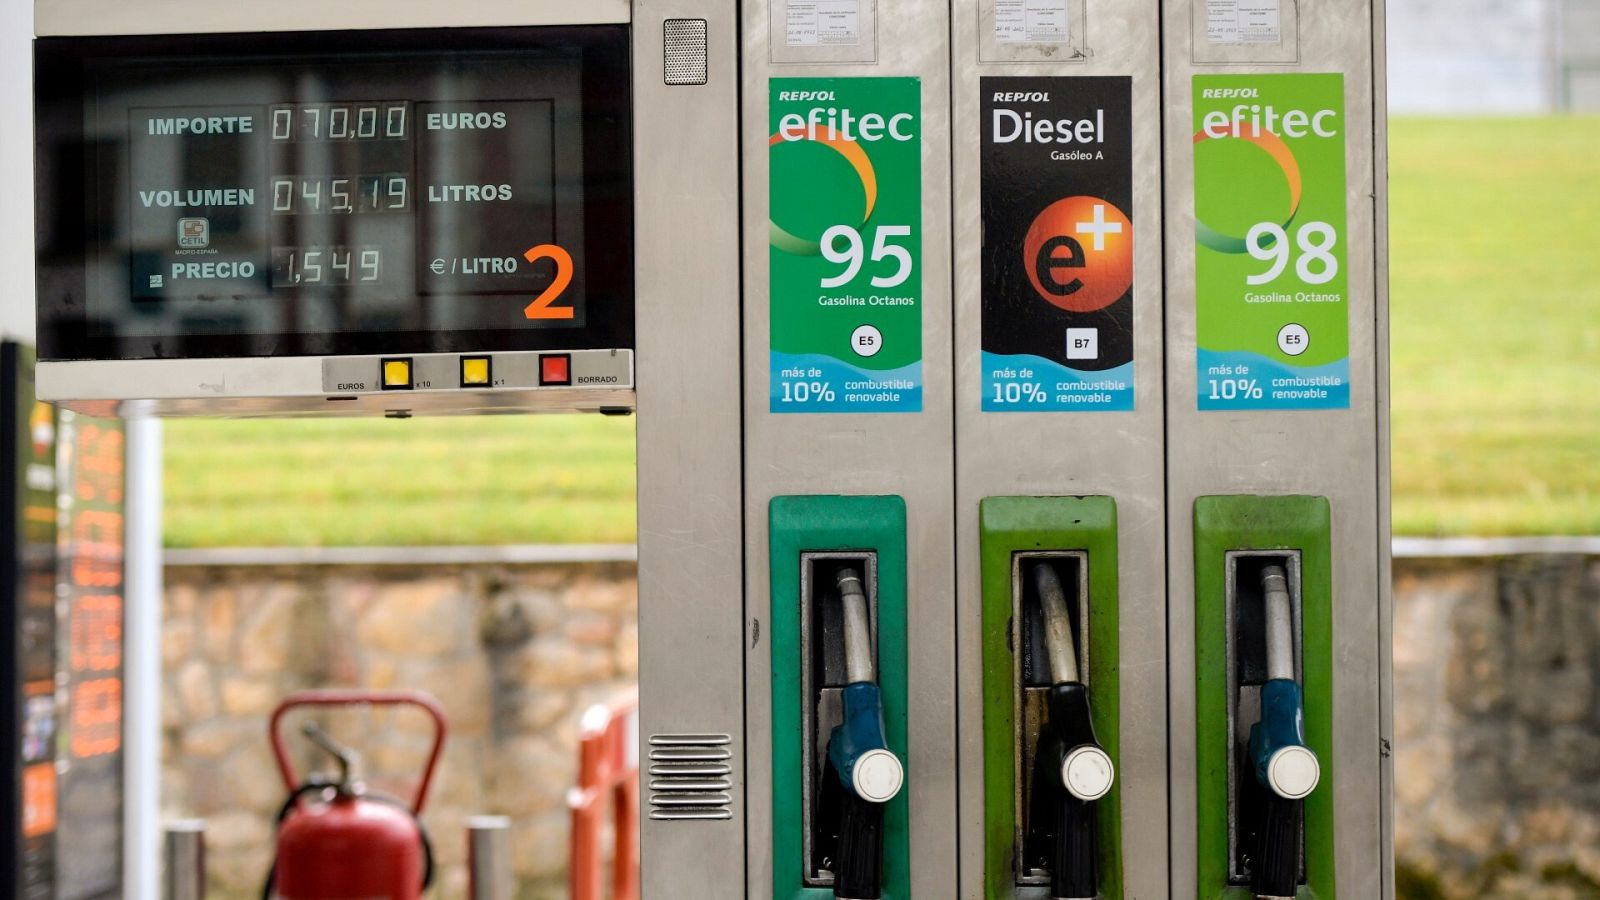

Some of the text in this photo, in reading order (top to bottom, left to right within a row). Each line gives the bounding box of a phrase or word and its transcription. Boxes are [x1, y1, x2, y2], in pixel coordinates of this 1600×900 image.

[779, 91, 836, 101] REPSOL
[994, 92, 1049, 102] REPSOL
[1203, 88, 1259, 98] REPSOL
[149, 107, 506, 140] IMPORTE 070,00 EUROS
[779, 108, 912, 141] efitec
[994, 109, 1103, 143] Diesel
[1203, 105, 1336, 138] efitec
[1051, 150, 1103, 160] Gasóleo A
[139, 178, 512, 213] VOLUMEN 045,19 LITROS
[820, 224, 912, 288] 95
[1246, 222, 1338, 285] 98
[173, 262, 254, 278] PRECIO
[430, 258, 445, 274] €
[463, 258, 517, 273] LITRO
[523, 244, 574, 319] 2
[819, 295, 913, 305] Gasolina Octanos
[1245, 292, 1341, 303] Gasolina Octanos
[860, 337, 873, 345] E5
[1075, 339, 1089, 348] B7
[1286, 335, 1300, 344] E5
[782, 368, 821, 377] más de
[993, 368, 1032, 378] más de
[1208, 364, 1249, 375] más de
[844, 379, 914, 390] combustible
[1056, 380, 1126, 390] combustible
[1272, 376, 1341, 387] combustible
[782, 382, 835, 401] 10%
[994, 383, 1046, 402] 10%
[1209, 379, 1262, 399] 10%
[1273, 389, 1327, 398] renovable
[844, 391, 900, 402] renovable
[1057, 393, 1111, 402] renovable
